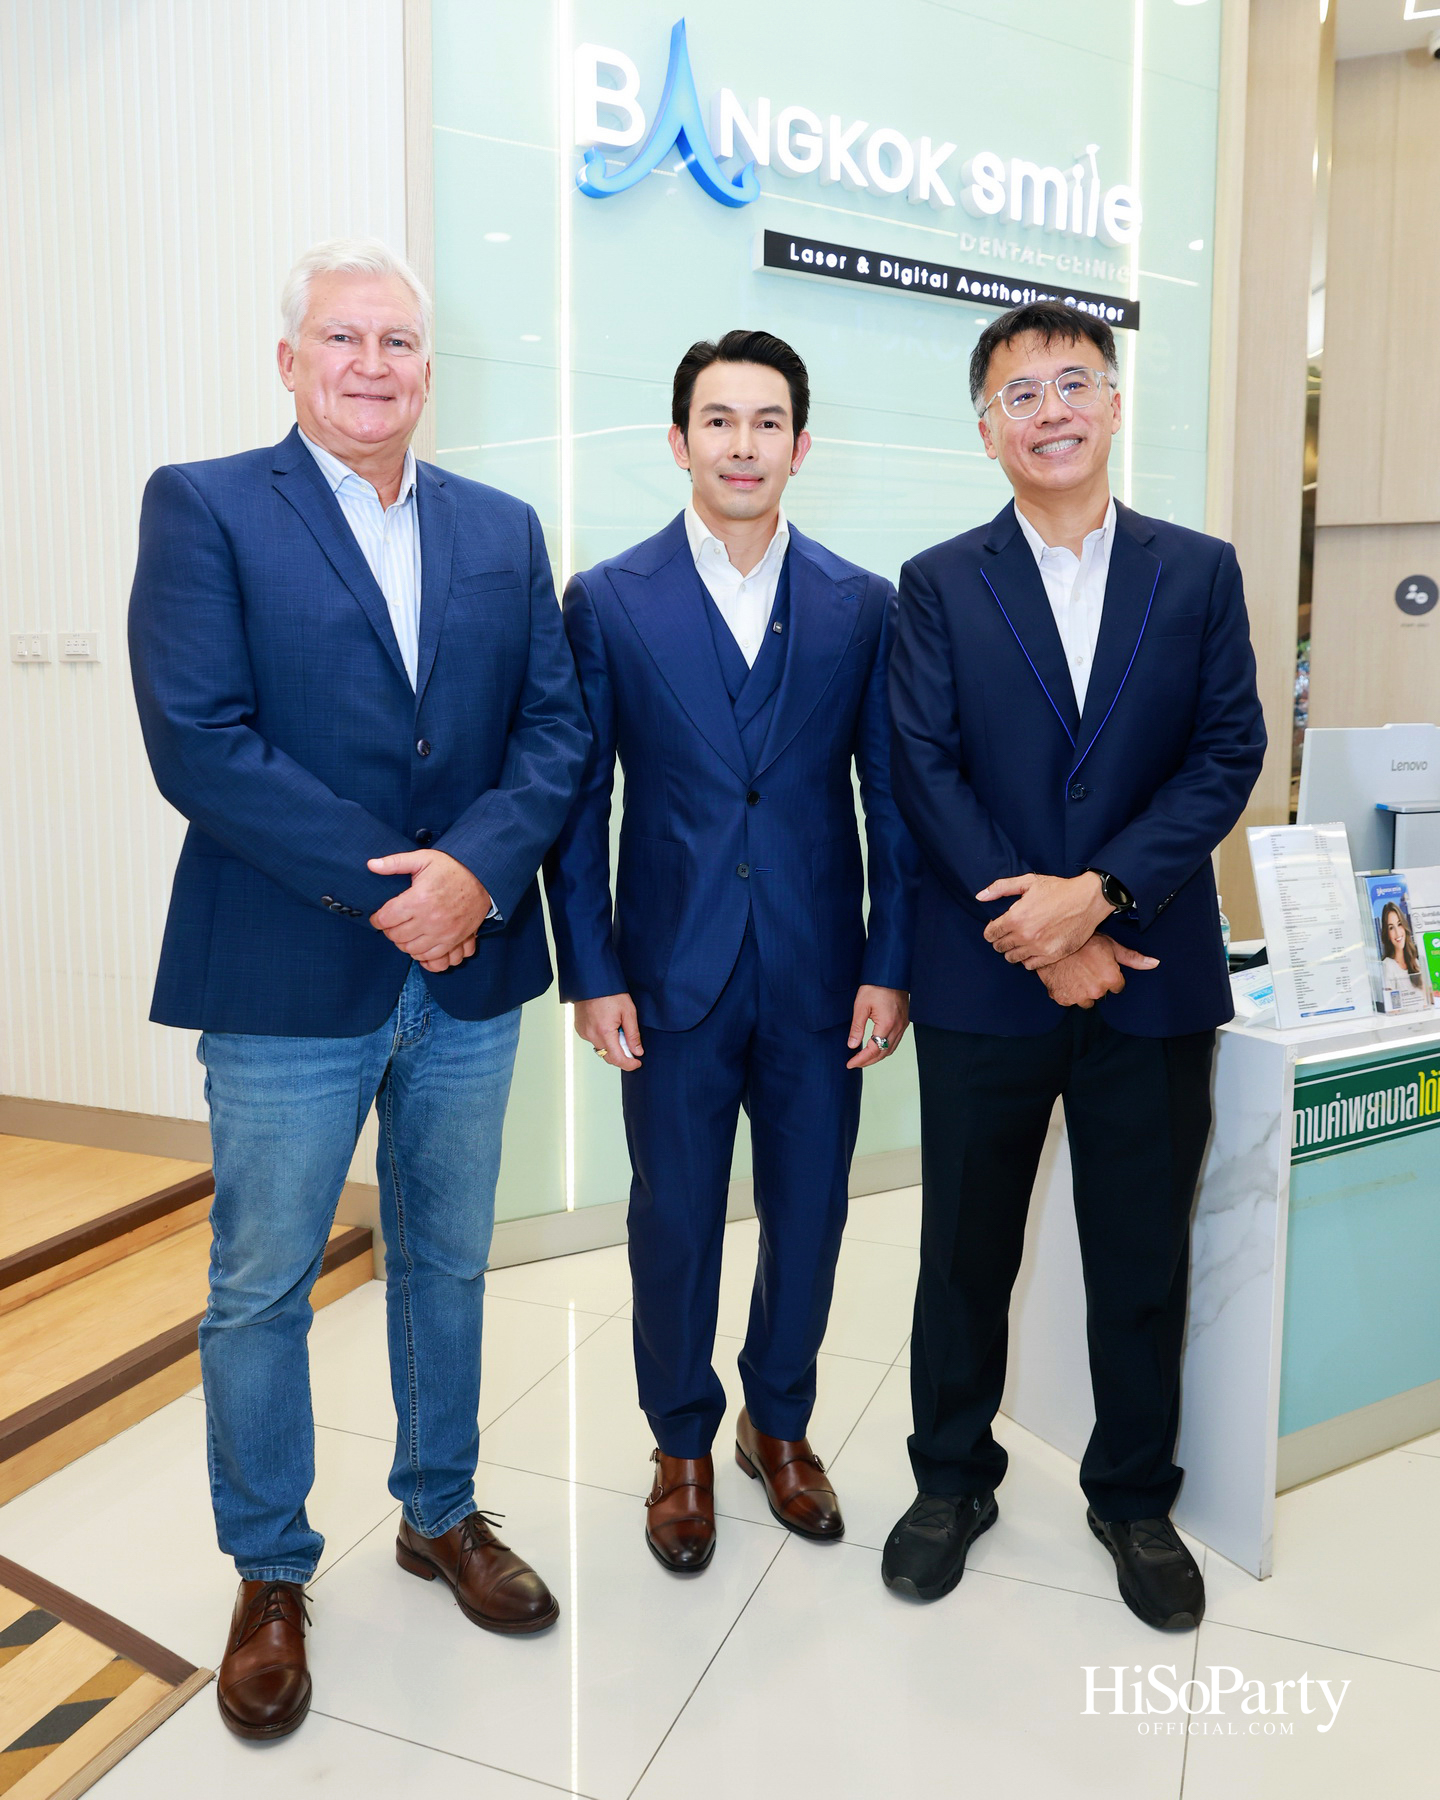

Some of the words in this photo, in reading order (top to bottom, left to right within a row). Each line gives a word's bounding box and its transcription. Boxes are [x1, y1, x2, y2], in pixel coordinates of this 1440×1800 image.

[573, 16, 958, 208] BANGKOK
[790, 243, 847, 270] Laser
[856, 256, 870, 275] &
[879, 260, 949, 289] Digital
[959, 232, 1048, 268] DENTAL
[1055, 253, 1132, 284] CLINIC
[1391, 759, 1428, 771] Lenovo
